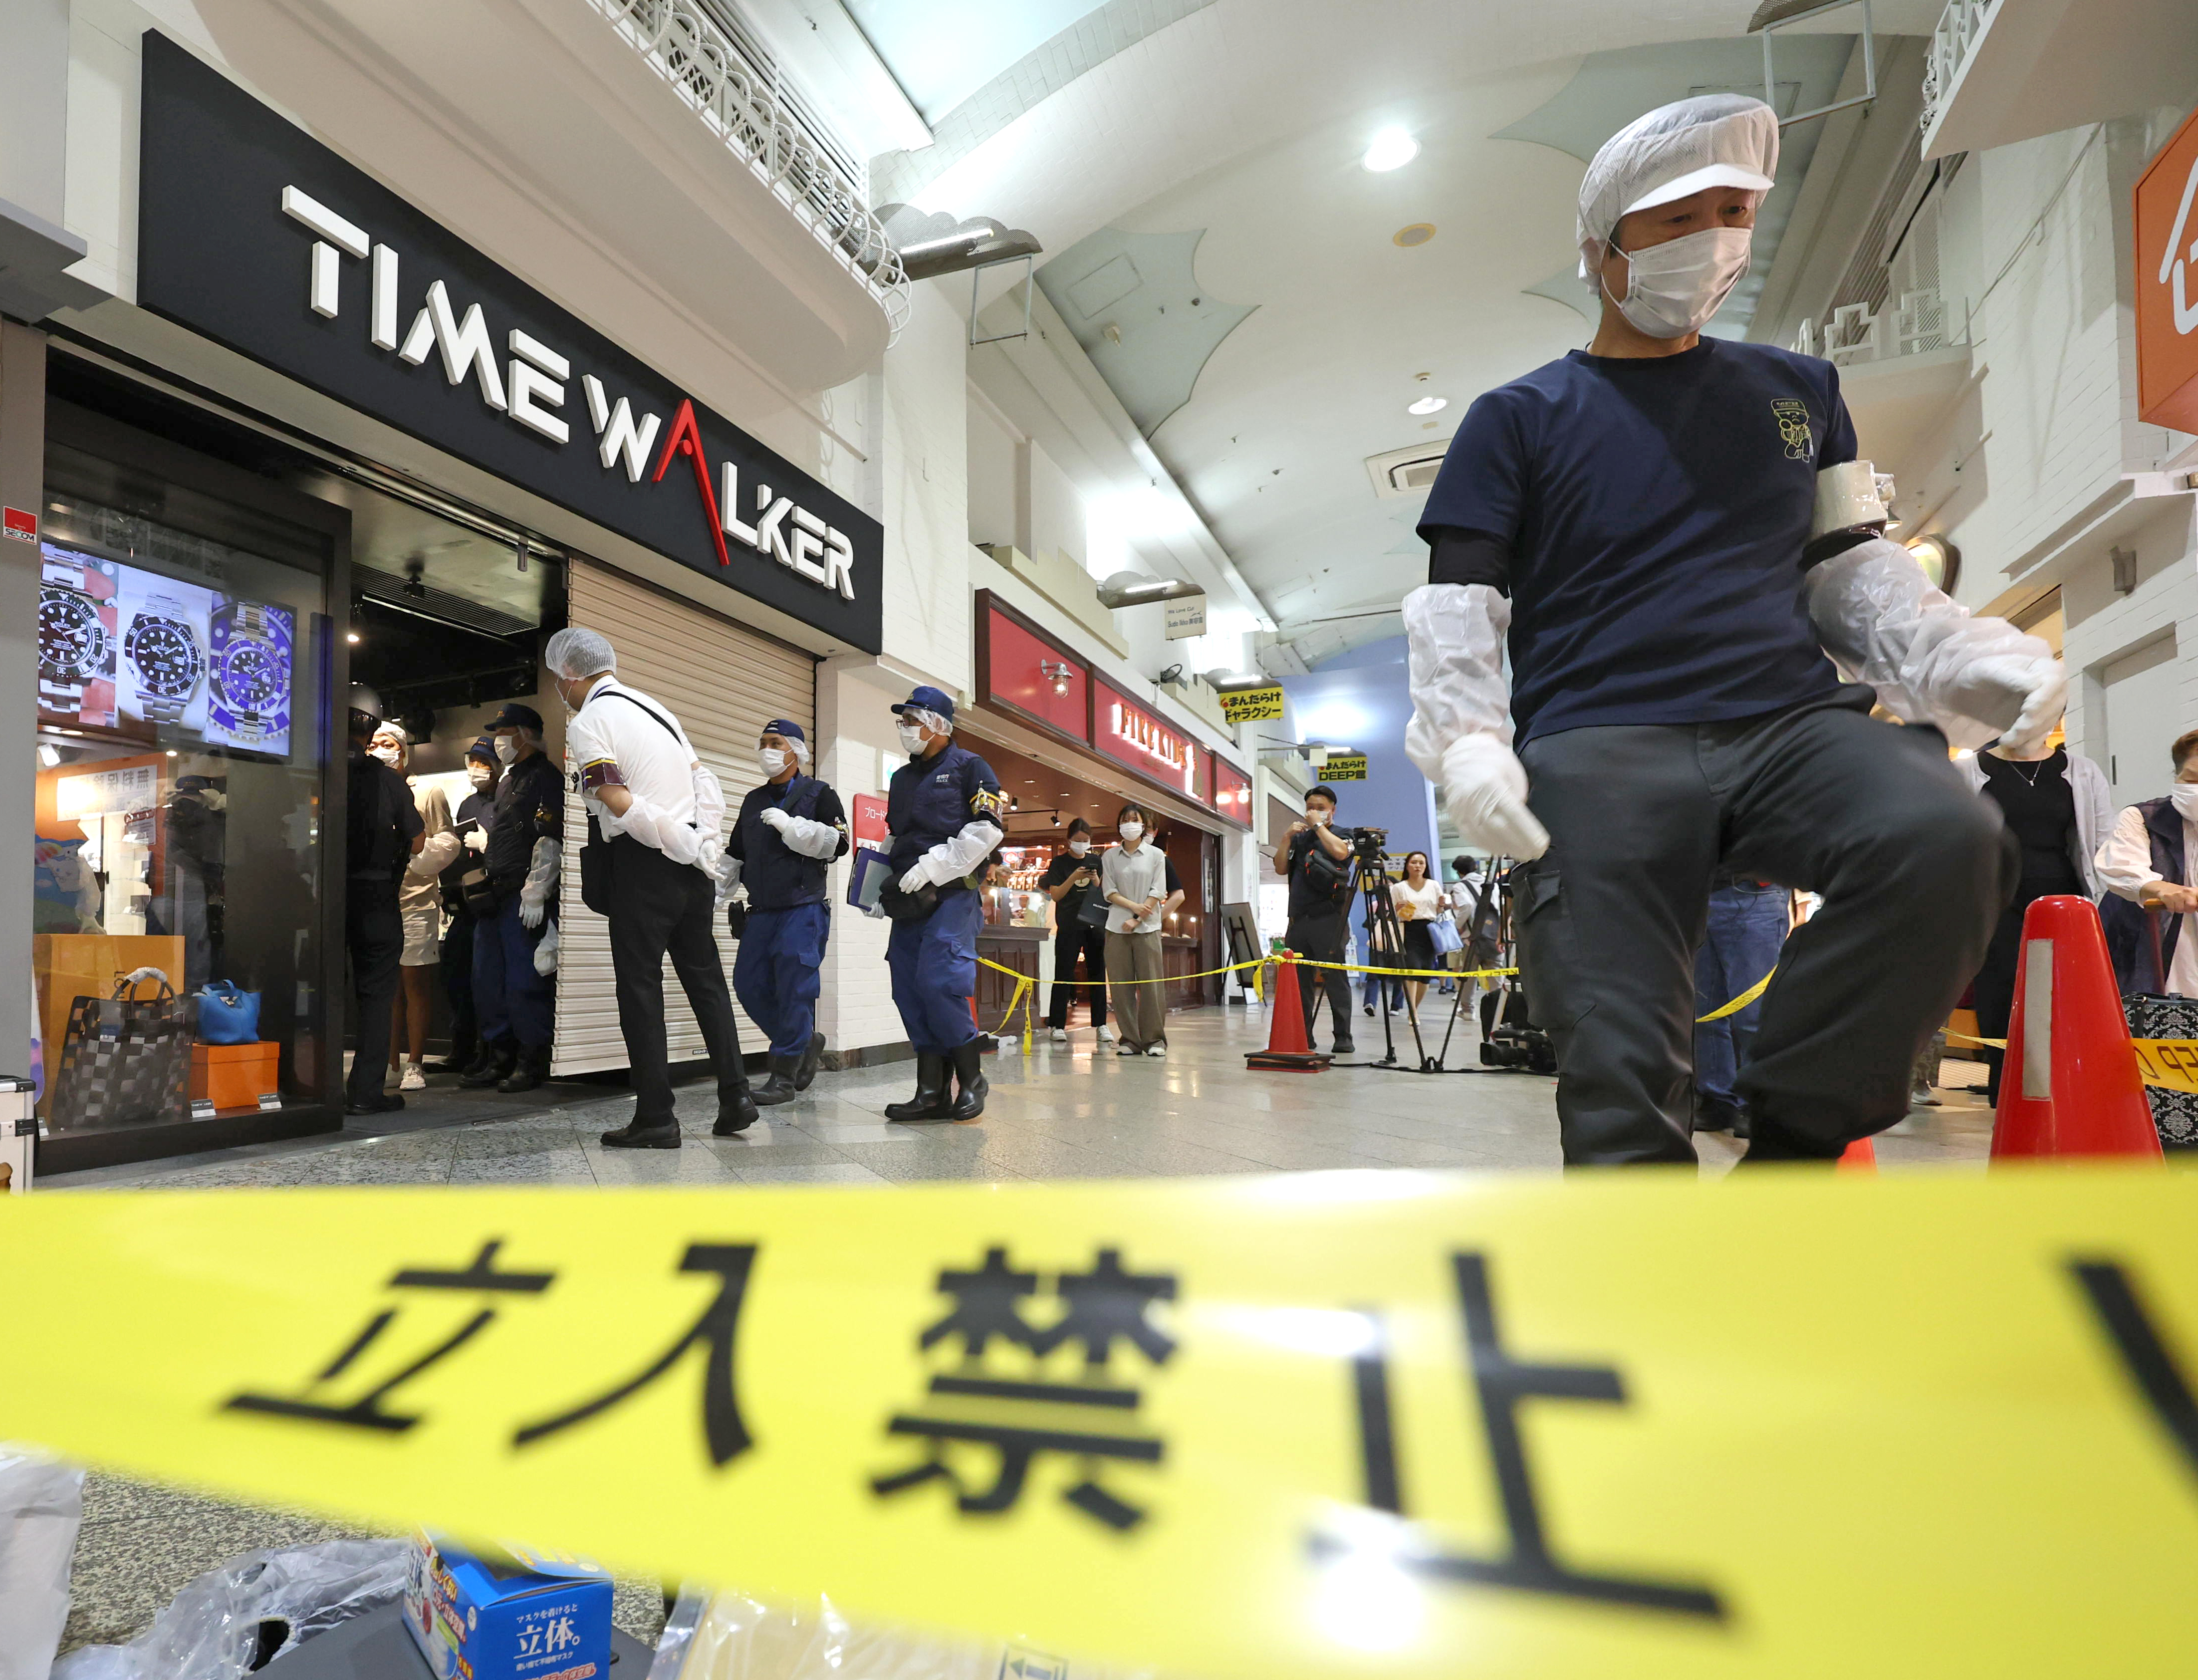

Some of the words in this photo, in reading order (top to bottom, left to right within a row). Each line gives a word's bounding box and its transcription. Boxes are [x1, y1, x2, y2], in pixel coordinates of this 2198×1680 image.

[5, 528, 34, 542] SECOM
[1229, 692, 1281, 707] まんだらけ
[1326, 760, 1366, 770] まんだらけ
[217, 1232, 1736, 1628] 立入禁止
[513, 1617, 581, 1660] 立体。
